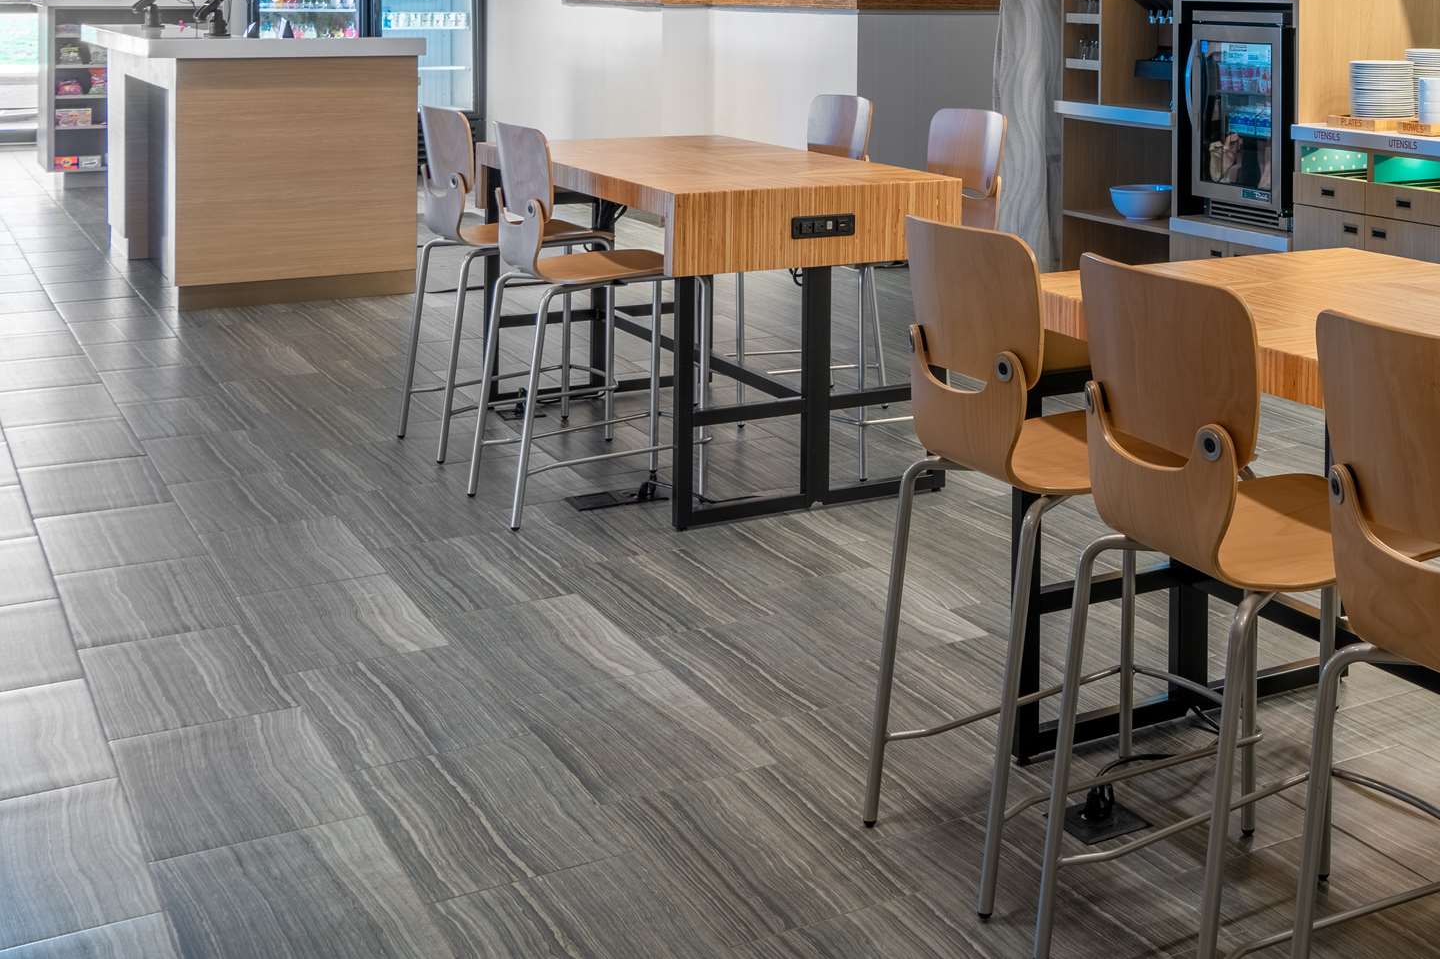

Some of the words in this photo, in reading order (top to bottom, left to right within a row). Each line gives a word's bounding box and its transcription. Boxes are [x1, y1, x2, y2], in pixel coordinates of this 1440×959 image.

[1341, 118, 1362, 128] PLATES
[1313, 130, 1341, 142] UTENSILS
[1388, 139, 1418, 150] UTENSILS
